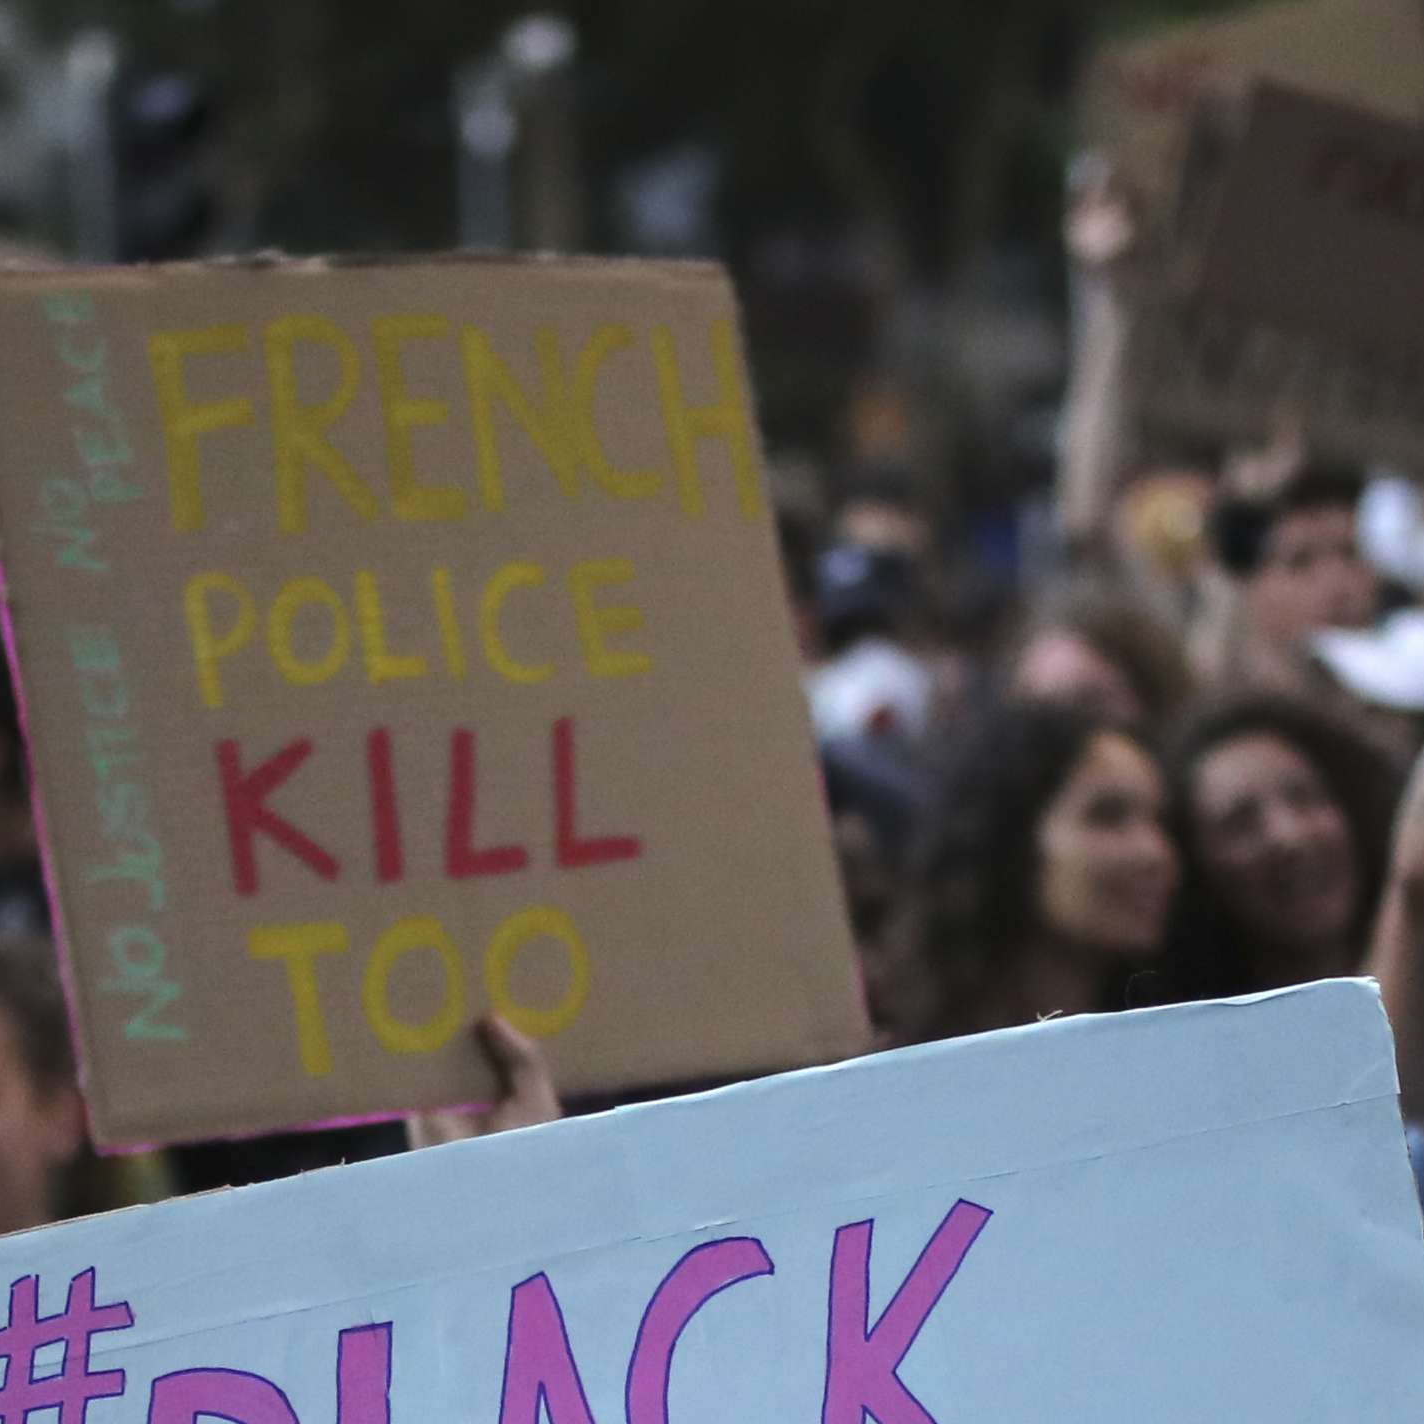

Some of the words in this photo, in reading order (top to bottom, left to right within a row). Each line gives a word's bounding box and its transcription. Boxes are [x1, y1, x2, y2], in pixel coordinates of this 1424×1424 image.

[42, 290, 144, 504] PEACE
[147, 311, 766, 535] FRENCH
[28, 476, 110, 573] NO
[181, 556, 653, 708] POLICE
[67, 626, 166, 910] JUSTICE
[215, 716, 641, 897] KILL
[91, 922, 188, 1042] NO
[247, 904, 591, 1077] TOO
